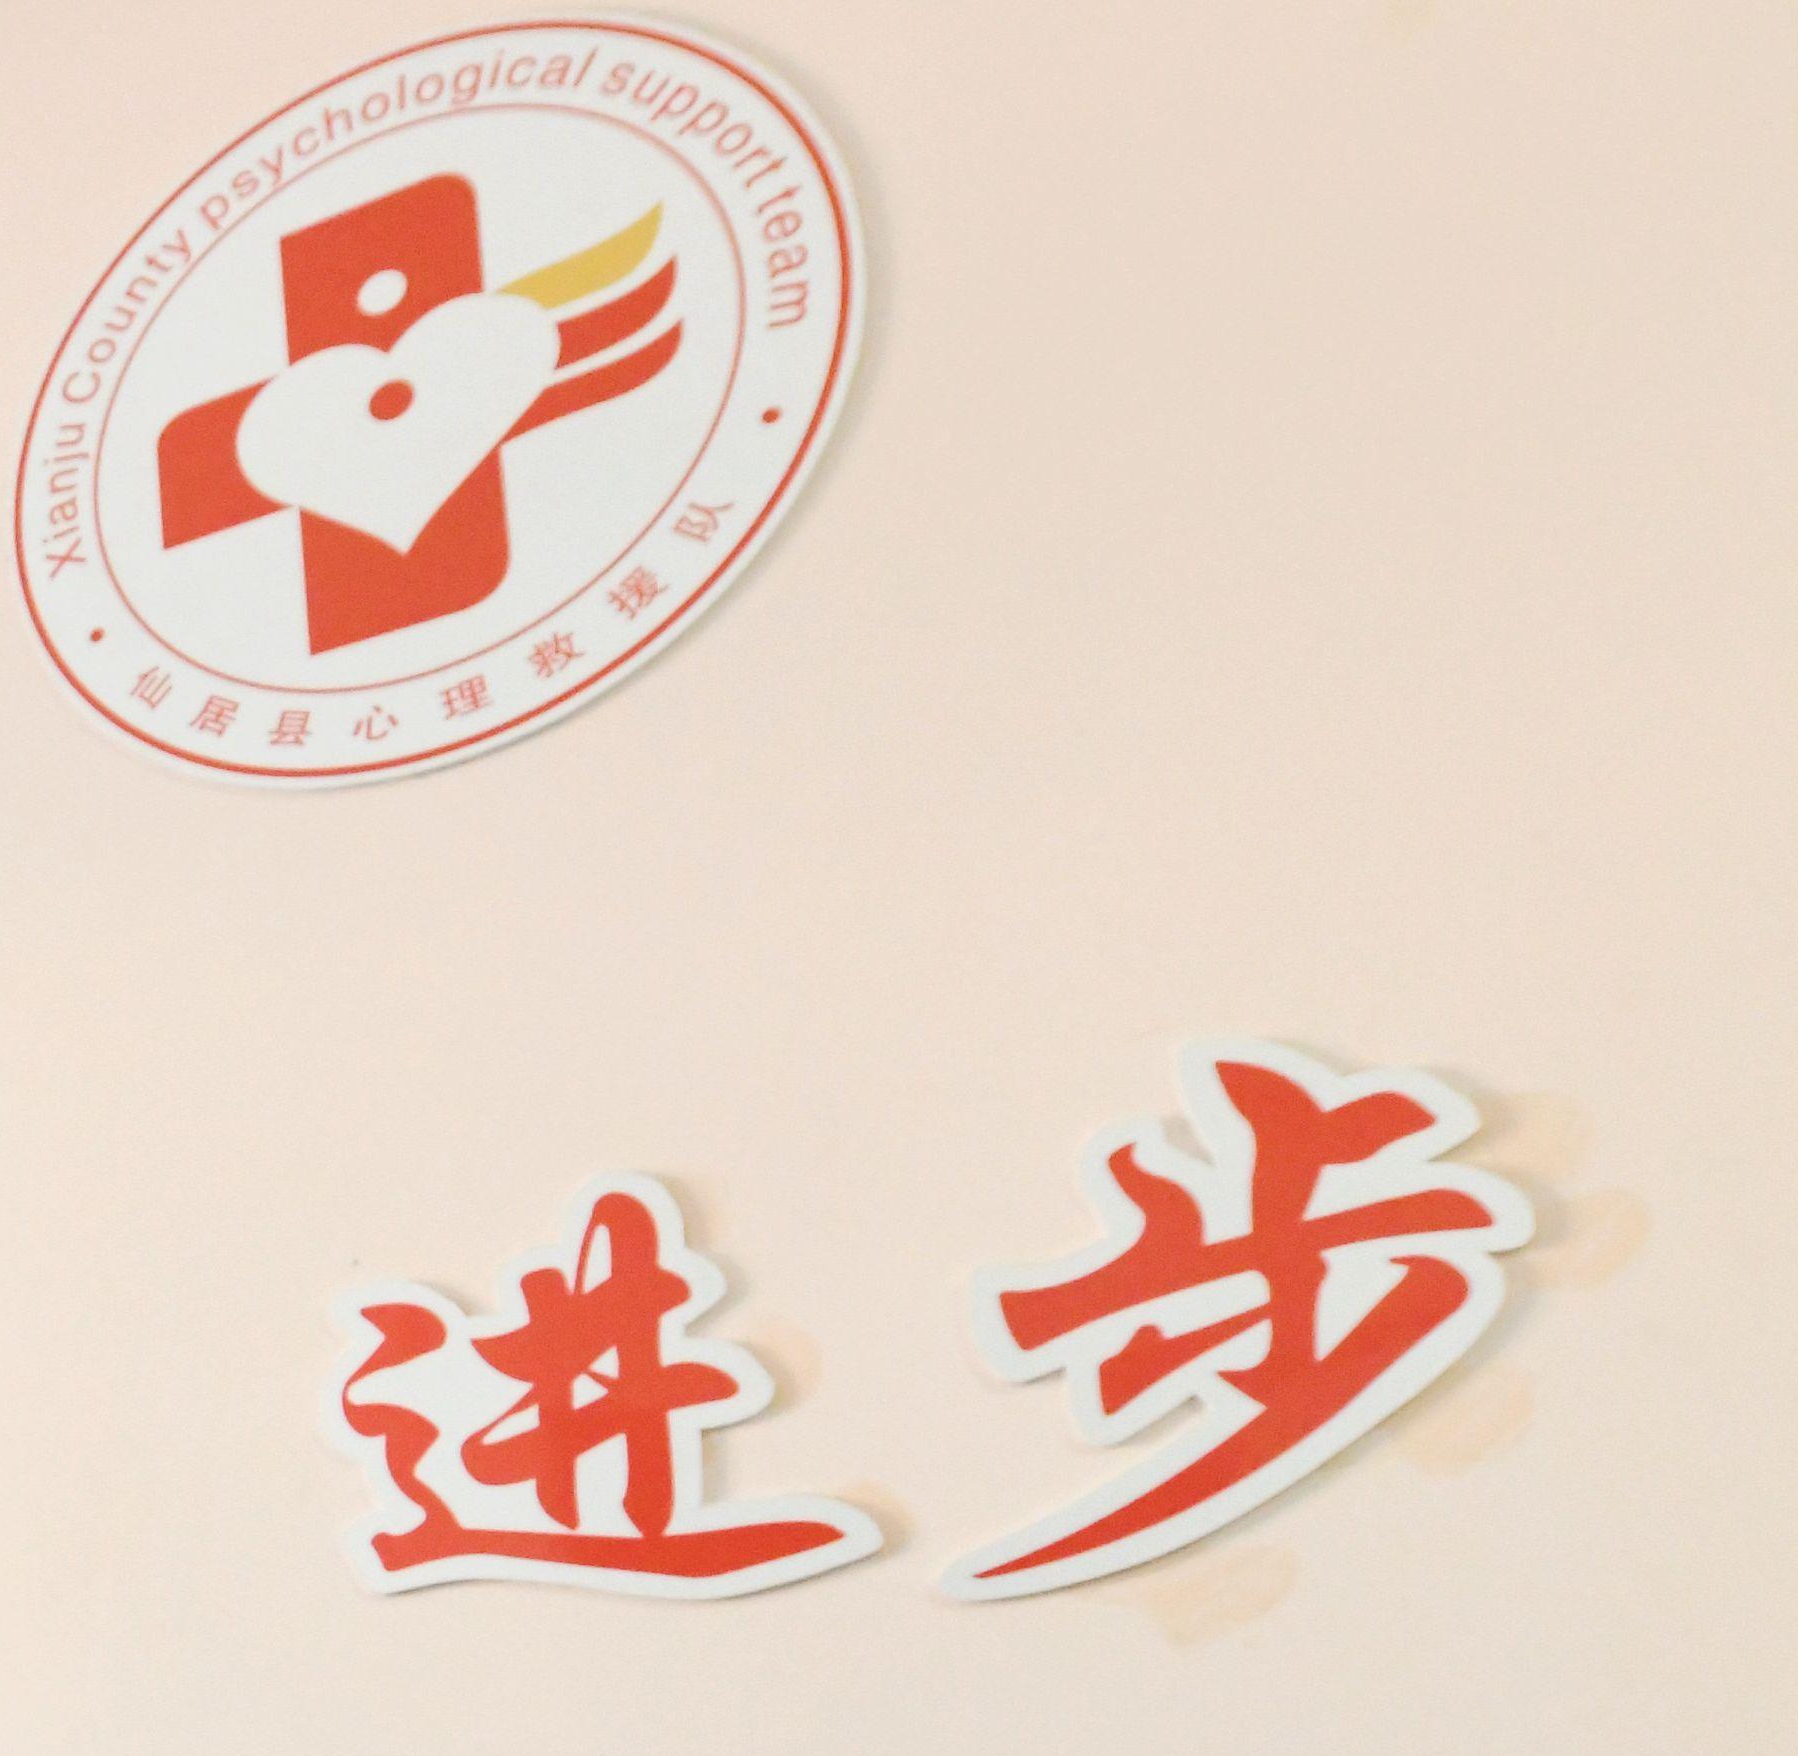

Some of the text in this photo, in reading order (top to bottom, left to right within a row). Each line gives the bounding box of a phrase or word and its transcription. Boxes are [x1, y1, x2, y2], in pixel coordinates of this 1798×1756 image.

[42, 44, 810, 581] Xianju County psychological support team
[128, 496, 735, 748] 仙居县心理救援队
[338, 1057, 1497, 1582] 进步
